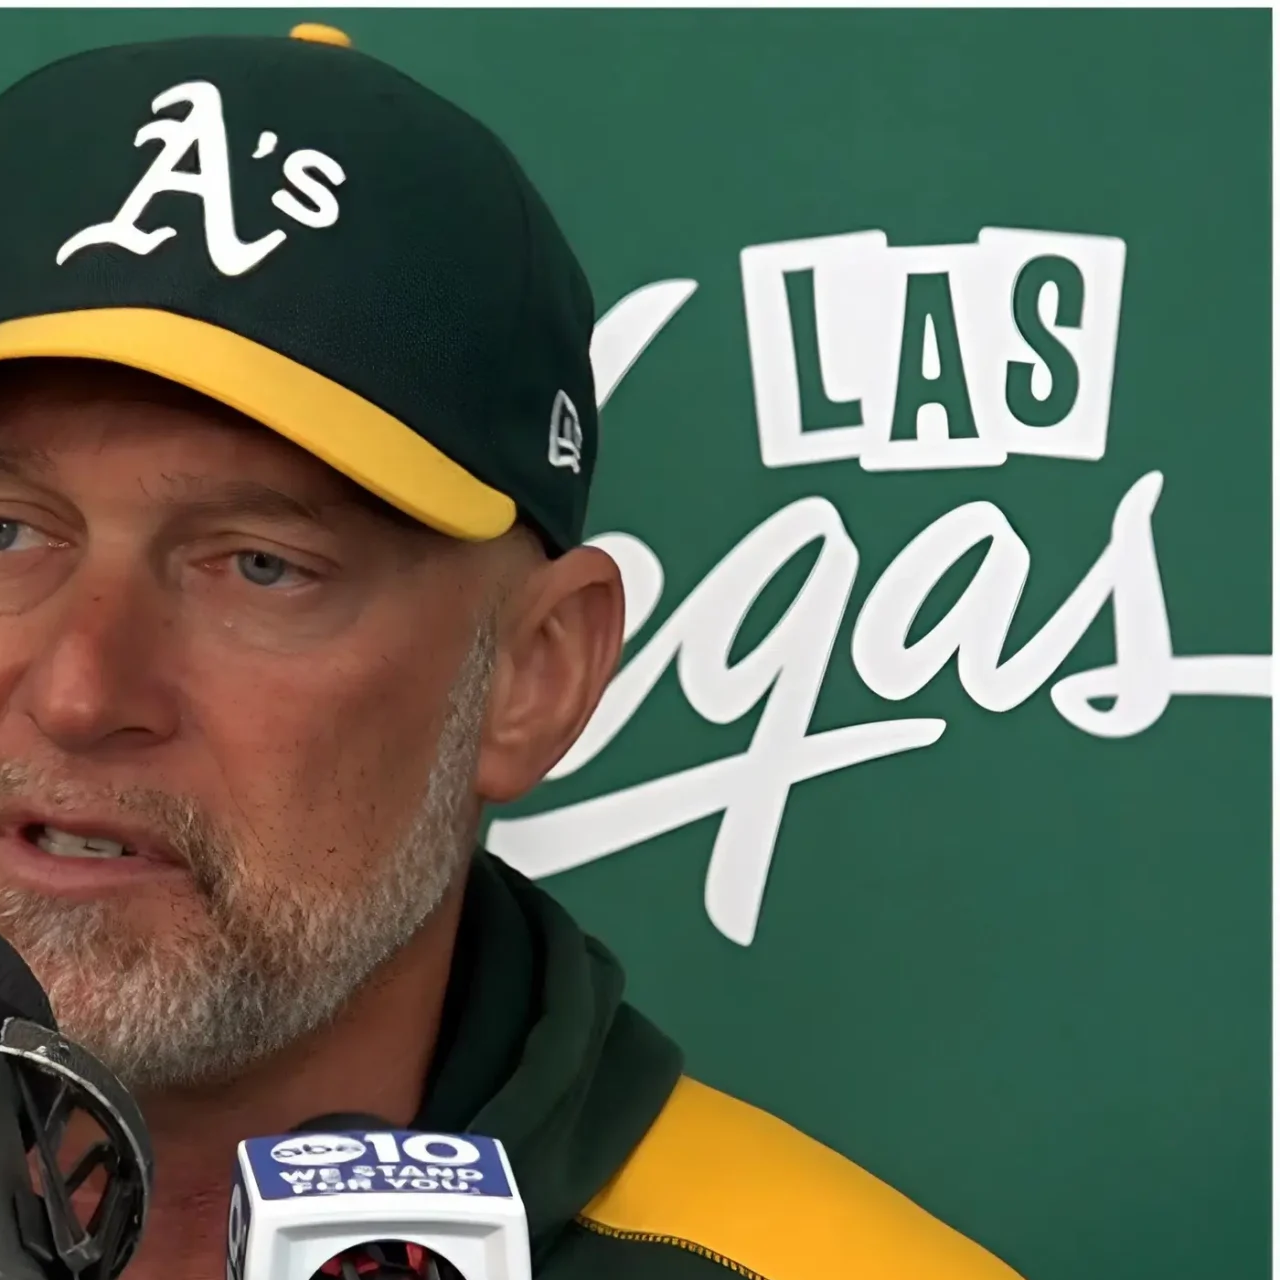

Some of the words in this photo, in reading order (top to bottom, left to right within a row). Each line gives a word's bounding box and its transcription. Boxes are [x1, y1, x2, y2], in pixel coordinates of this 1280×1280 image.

[782, 253, 1086, 442] LAS
[279, 1167, 342, 1184] WE
[352, 1164, 484, 1182] STAND
[291, 1179, 372, 1195] FOR
